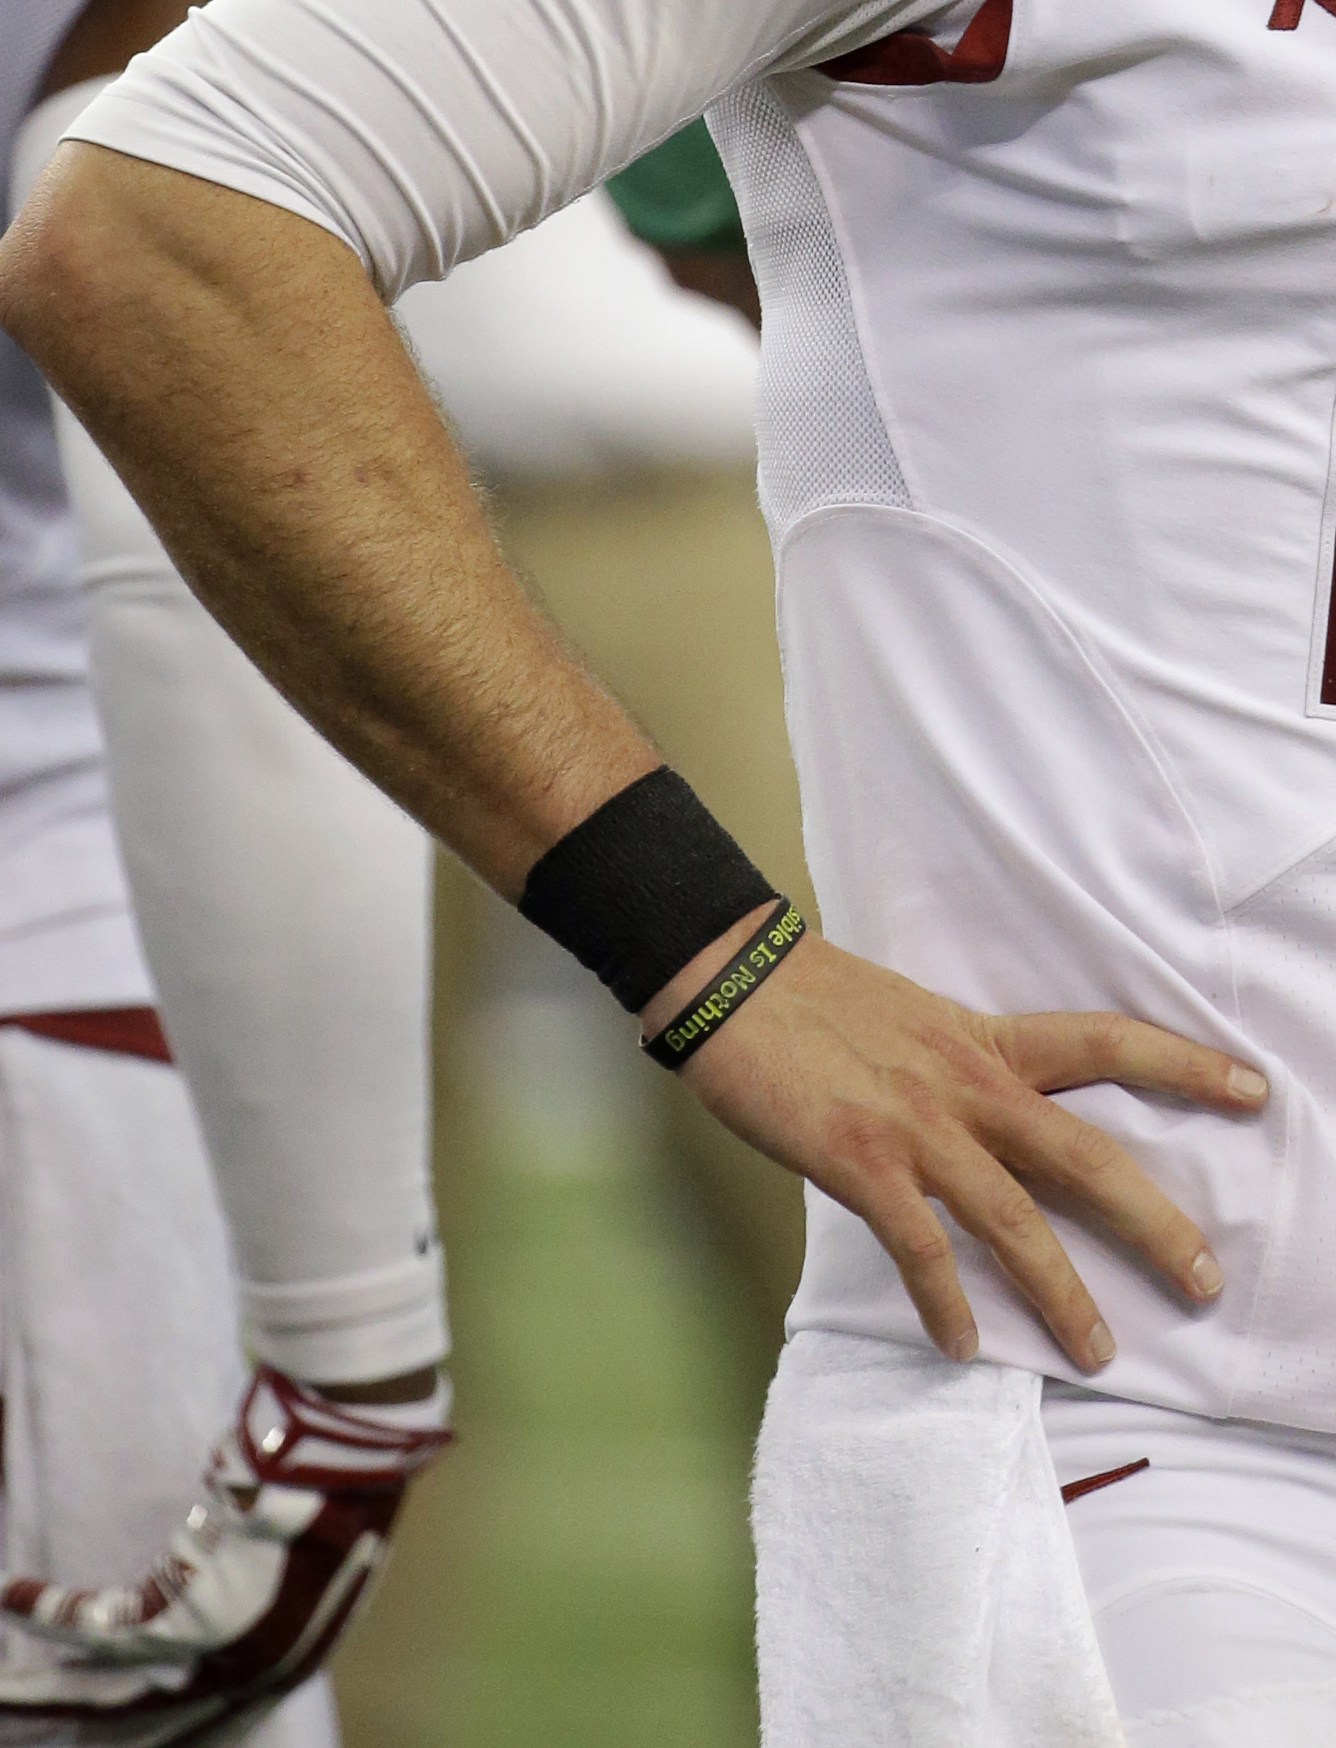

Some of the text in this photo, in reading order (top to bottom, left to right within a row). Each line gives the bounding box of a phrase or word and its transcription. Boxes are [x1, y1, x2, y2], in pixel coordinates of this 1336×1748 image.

[665, 904, 803, 1051] sible Is Nothing
